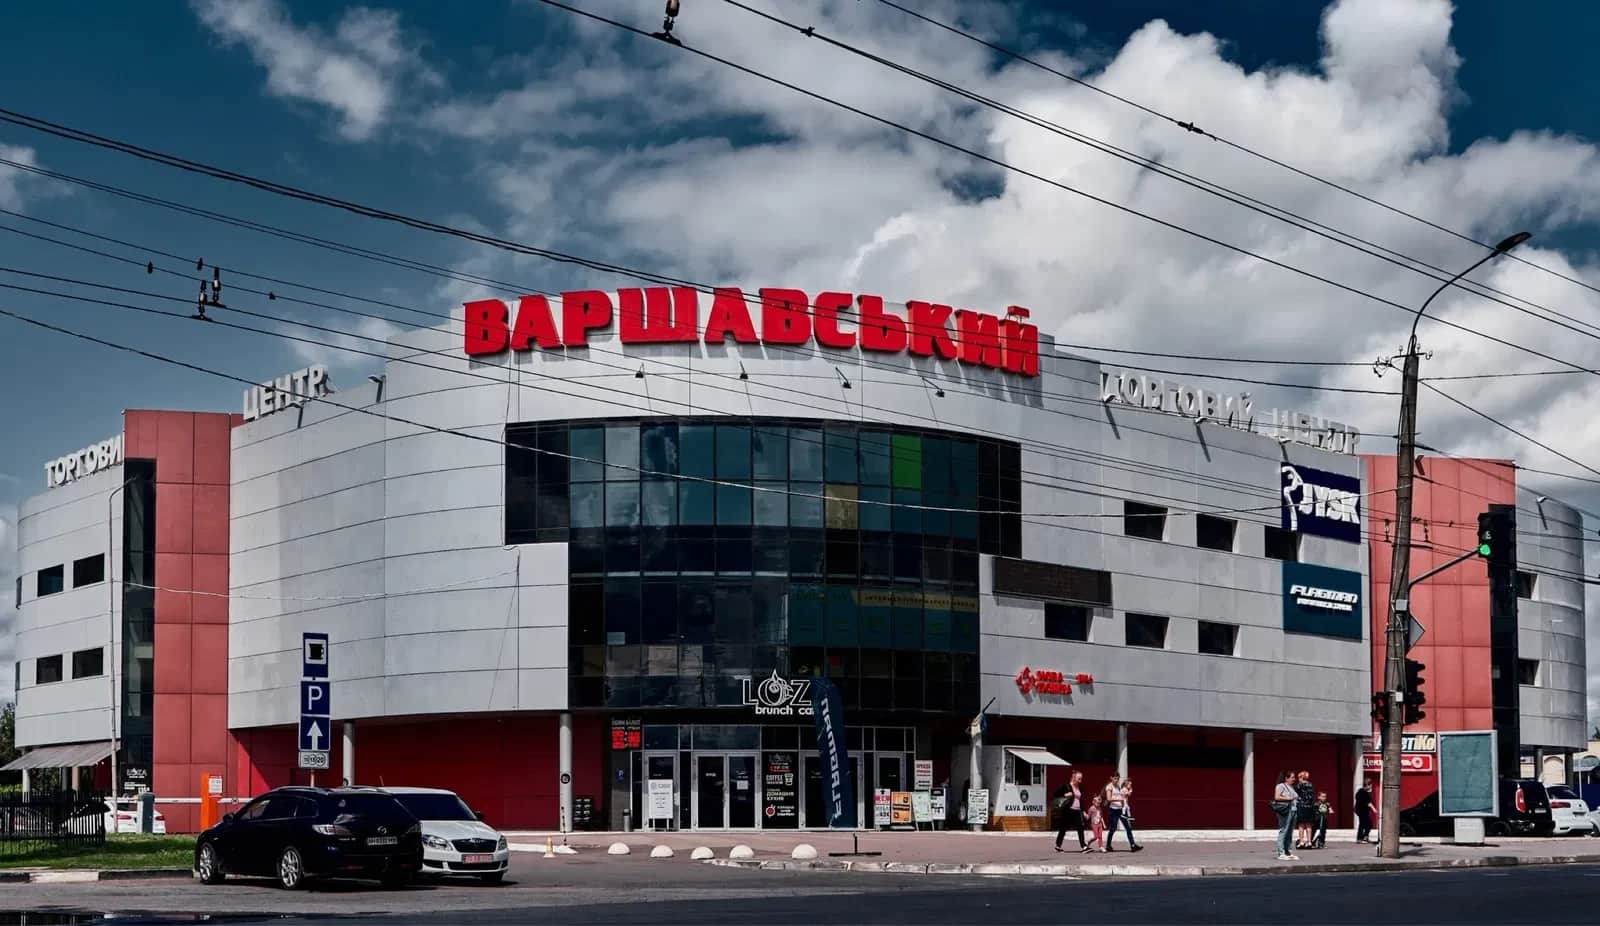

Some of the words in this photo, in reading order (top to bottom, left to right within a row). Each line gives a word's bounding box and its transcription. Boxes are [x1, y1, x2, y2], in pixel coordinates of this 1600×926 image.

[463, 287, 1040, 378] ВАРШАВСЬКИЙ
[243, 364, 328, 421] ЦЕНТР
[1100, 371, 1256, 432] ТОРГОВИЙ
[1272, 407, 1360, 455] ЦЕНТР
[1299, 482, 1360, 524] JYSK
[308, 685, 323, 711] P
[755, 705, 793, 716] brunch
[1005, 804, 1020, 812] KAVA
[1022, 804, 1044, 812] AVENUE
